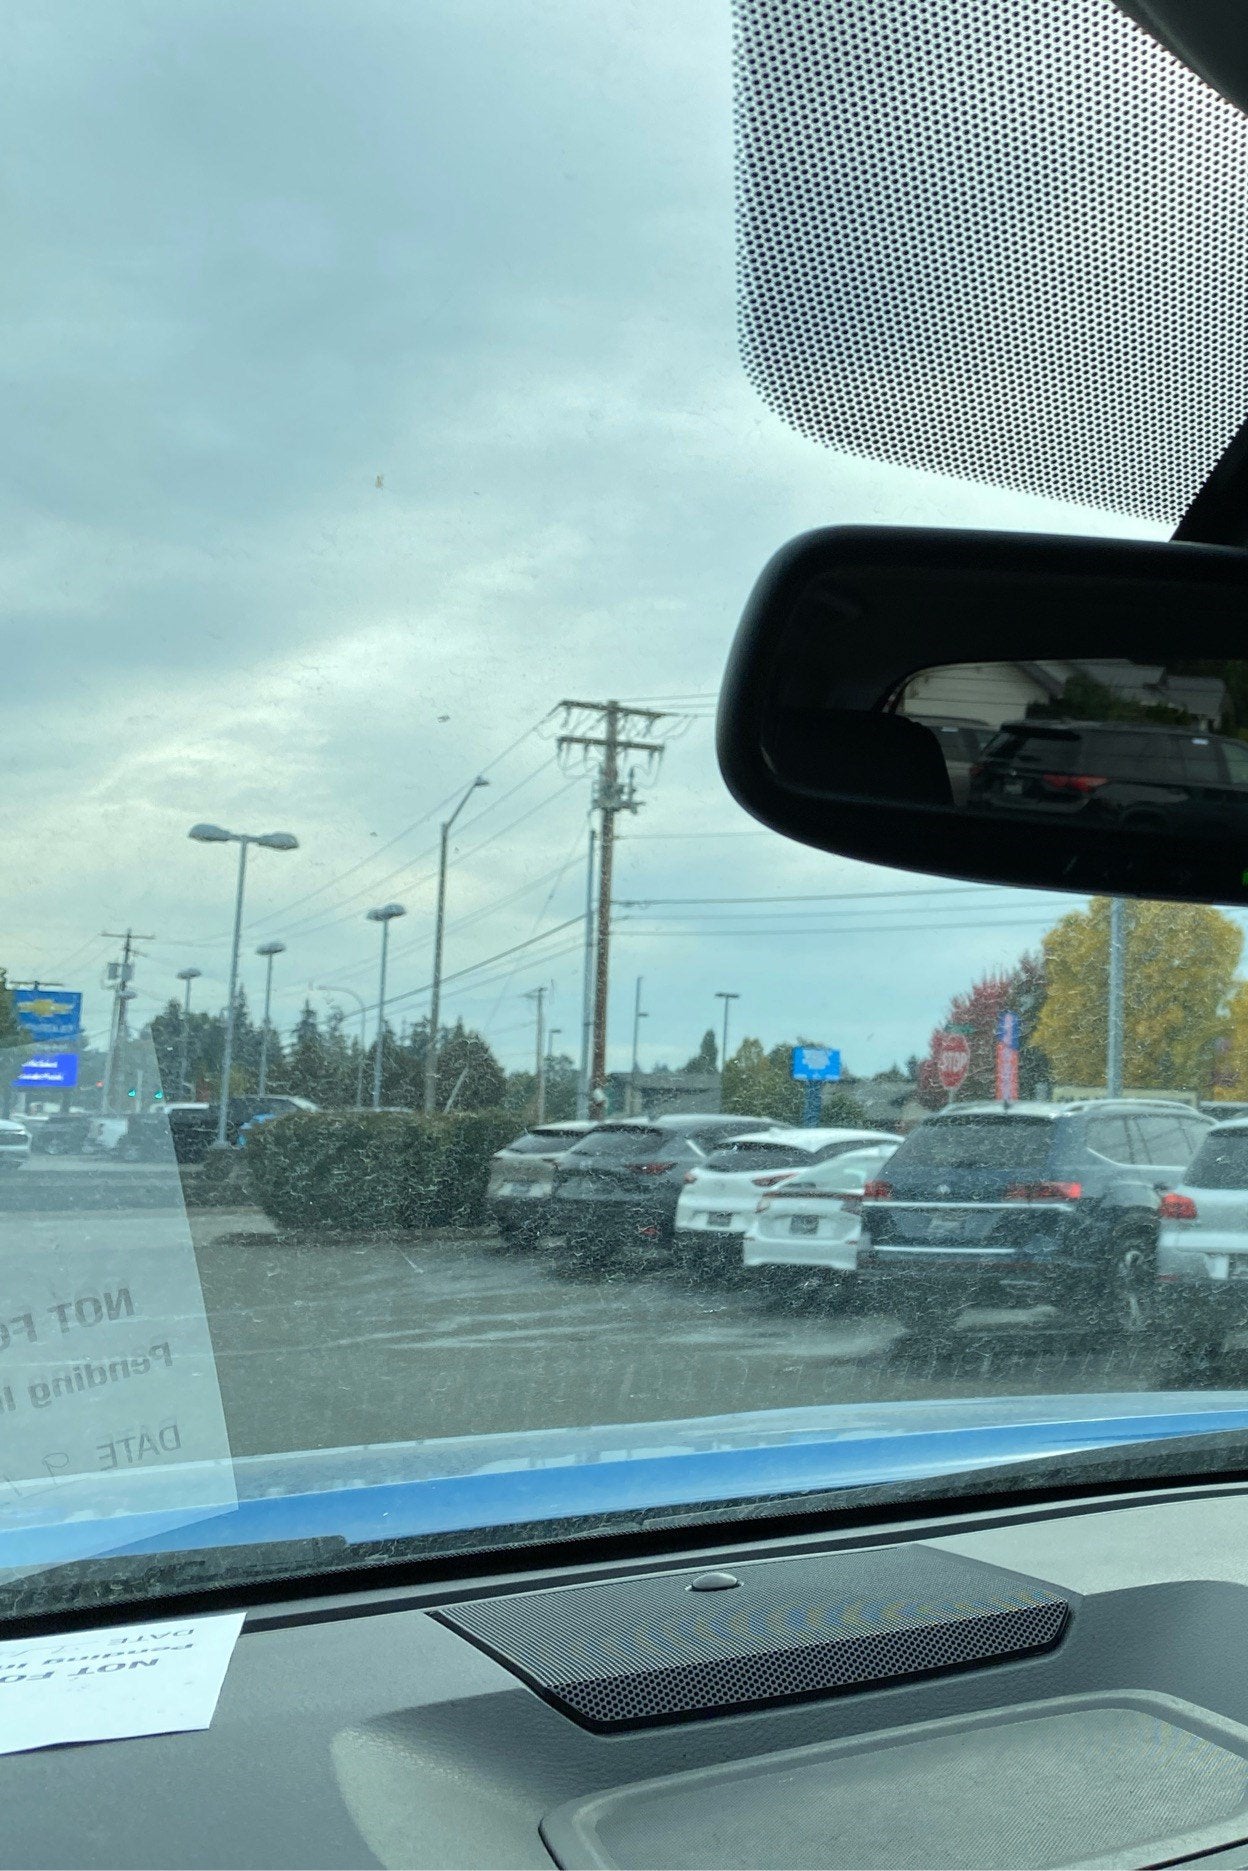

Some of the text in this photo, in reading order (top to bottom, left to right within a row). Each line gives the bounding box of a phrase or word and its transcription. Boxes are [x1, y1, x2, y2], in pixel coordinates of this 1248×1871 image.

[942, 1051, 968, 1071] STOP
[107, 1628, 194, 1647] DATE
[67, 1658, 160, 1677] NOT
